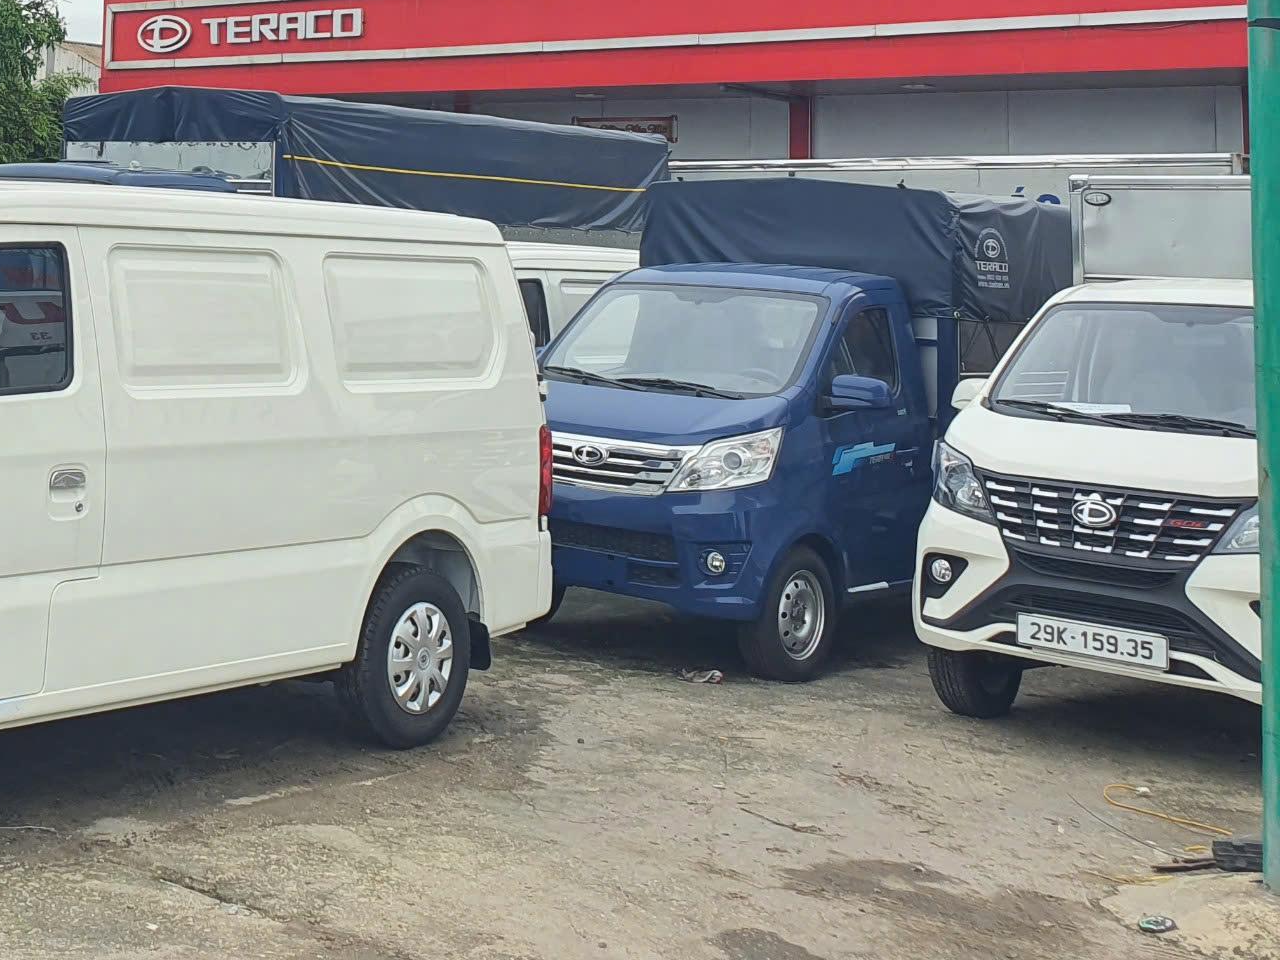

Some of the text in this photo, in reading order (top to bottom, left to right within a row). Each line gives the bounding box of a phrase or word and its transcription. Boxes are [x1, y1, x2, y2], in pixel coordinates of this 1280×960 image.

[201, 7, 363, 45] TERACO
[975, 260, 1009, 273] TERACO
[1029, 621, 1153, 660] 29K-159.35
